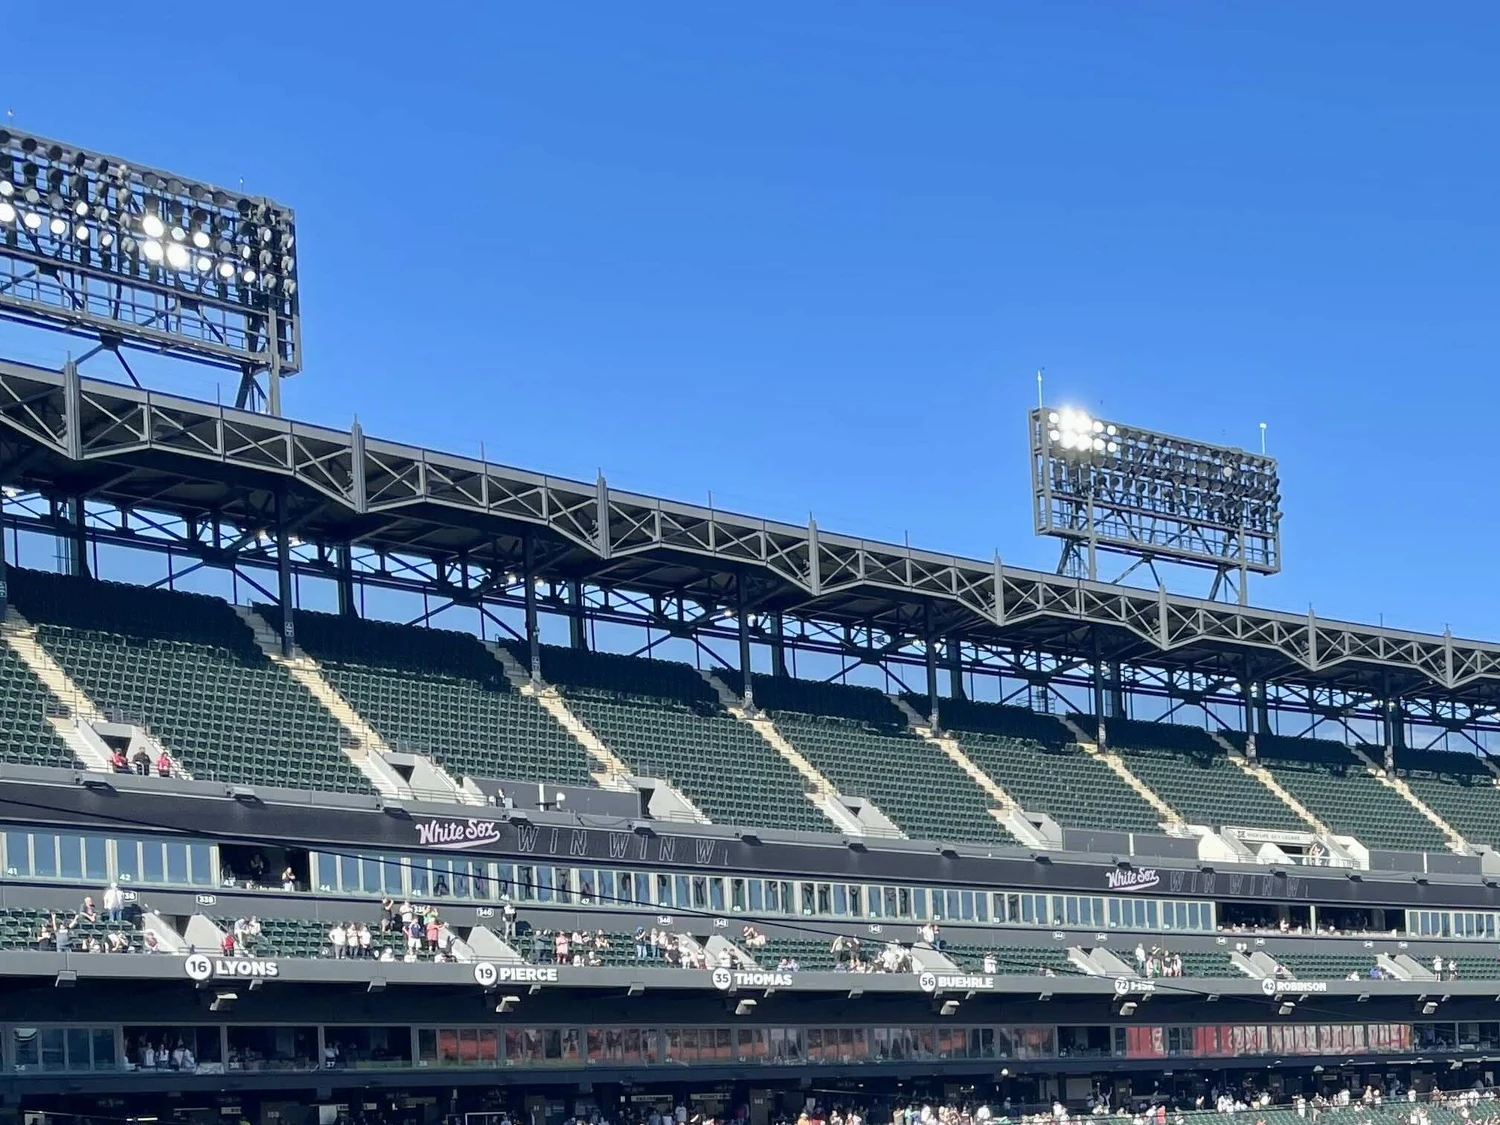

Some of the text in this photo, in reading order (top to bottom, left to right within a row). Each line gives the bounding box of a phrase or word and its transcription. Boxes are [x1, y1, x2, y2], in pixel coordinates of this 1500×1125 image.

[415, 819, 500, 845] White Sox
[1105, 868, 1160, 889] White Sox
[189, 960, 279, 976] 16 LYONS
[479, 967, 558, 982] 19 PIERCE
[714, 973, 793, 987] 35 THOMAS
[922, 977, 994, 989] 56 BUEHRLE
[1116, 981, 1128, 991] 72
[1264, 981, 1326, 992] 42 ROBINSON
